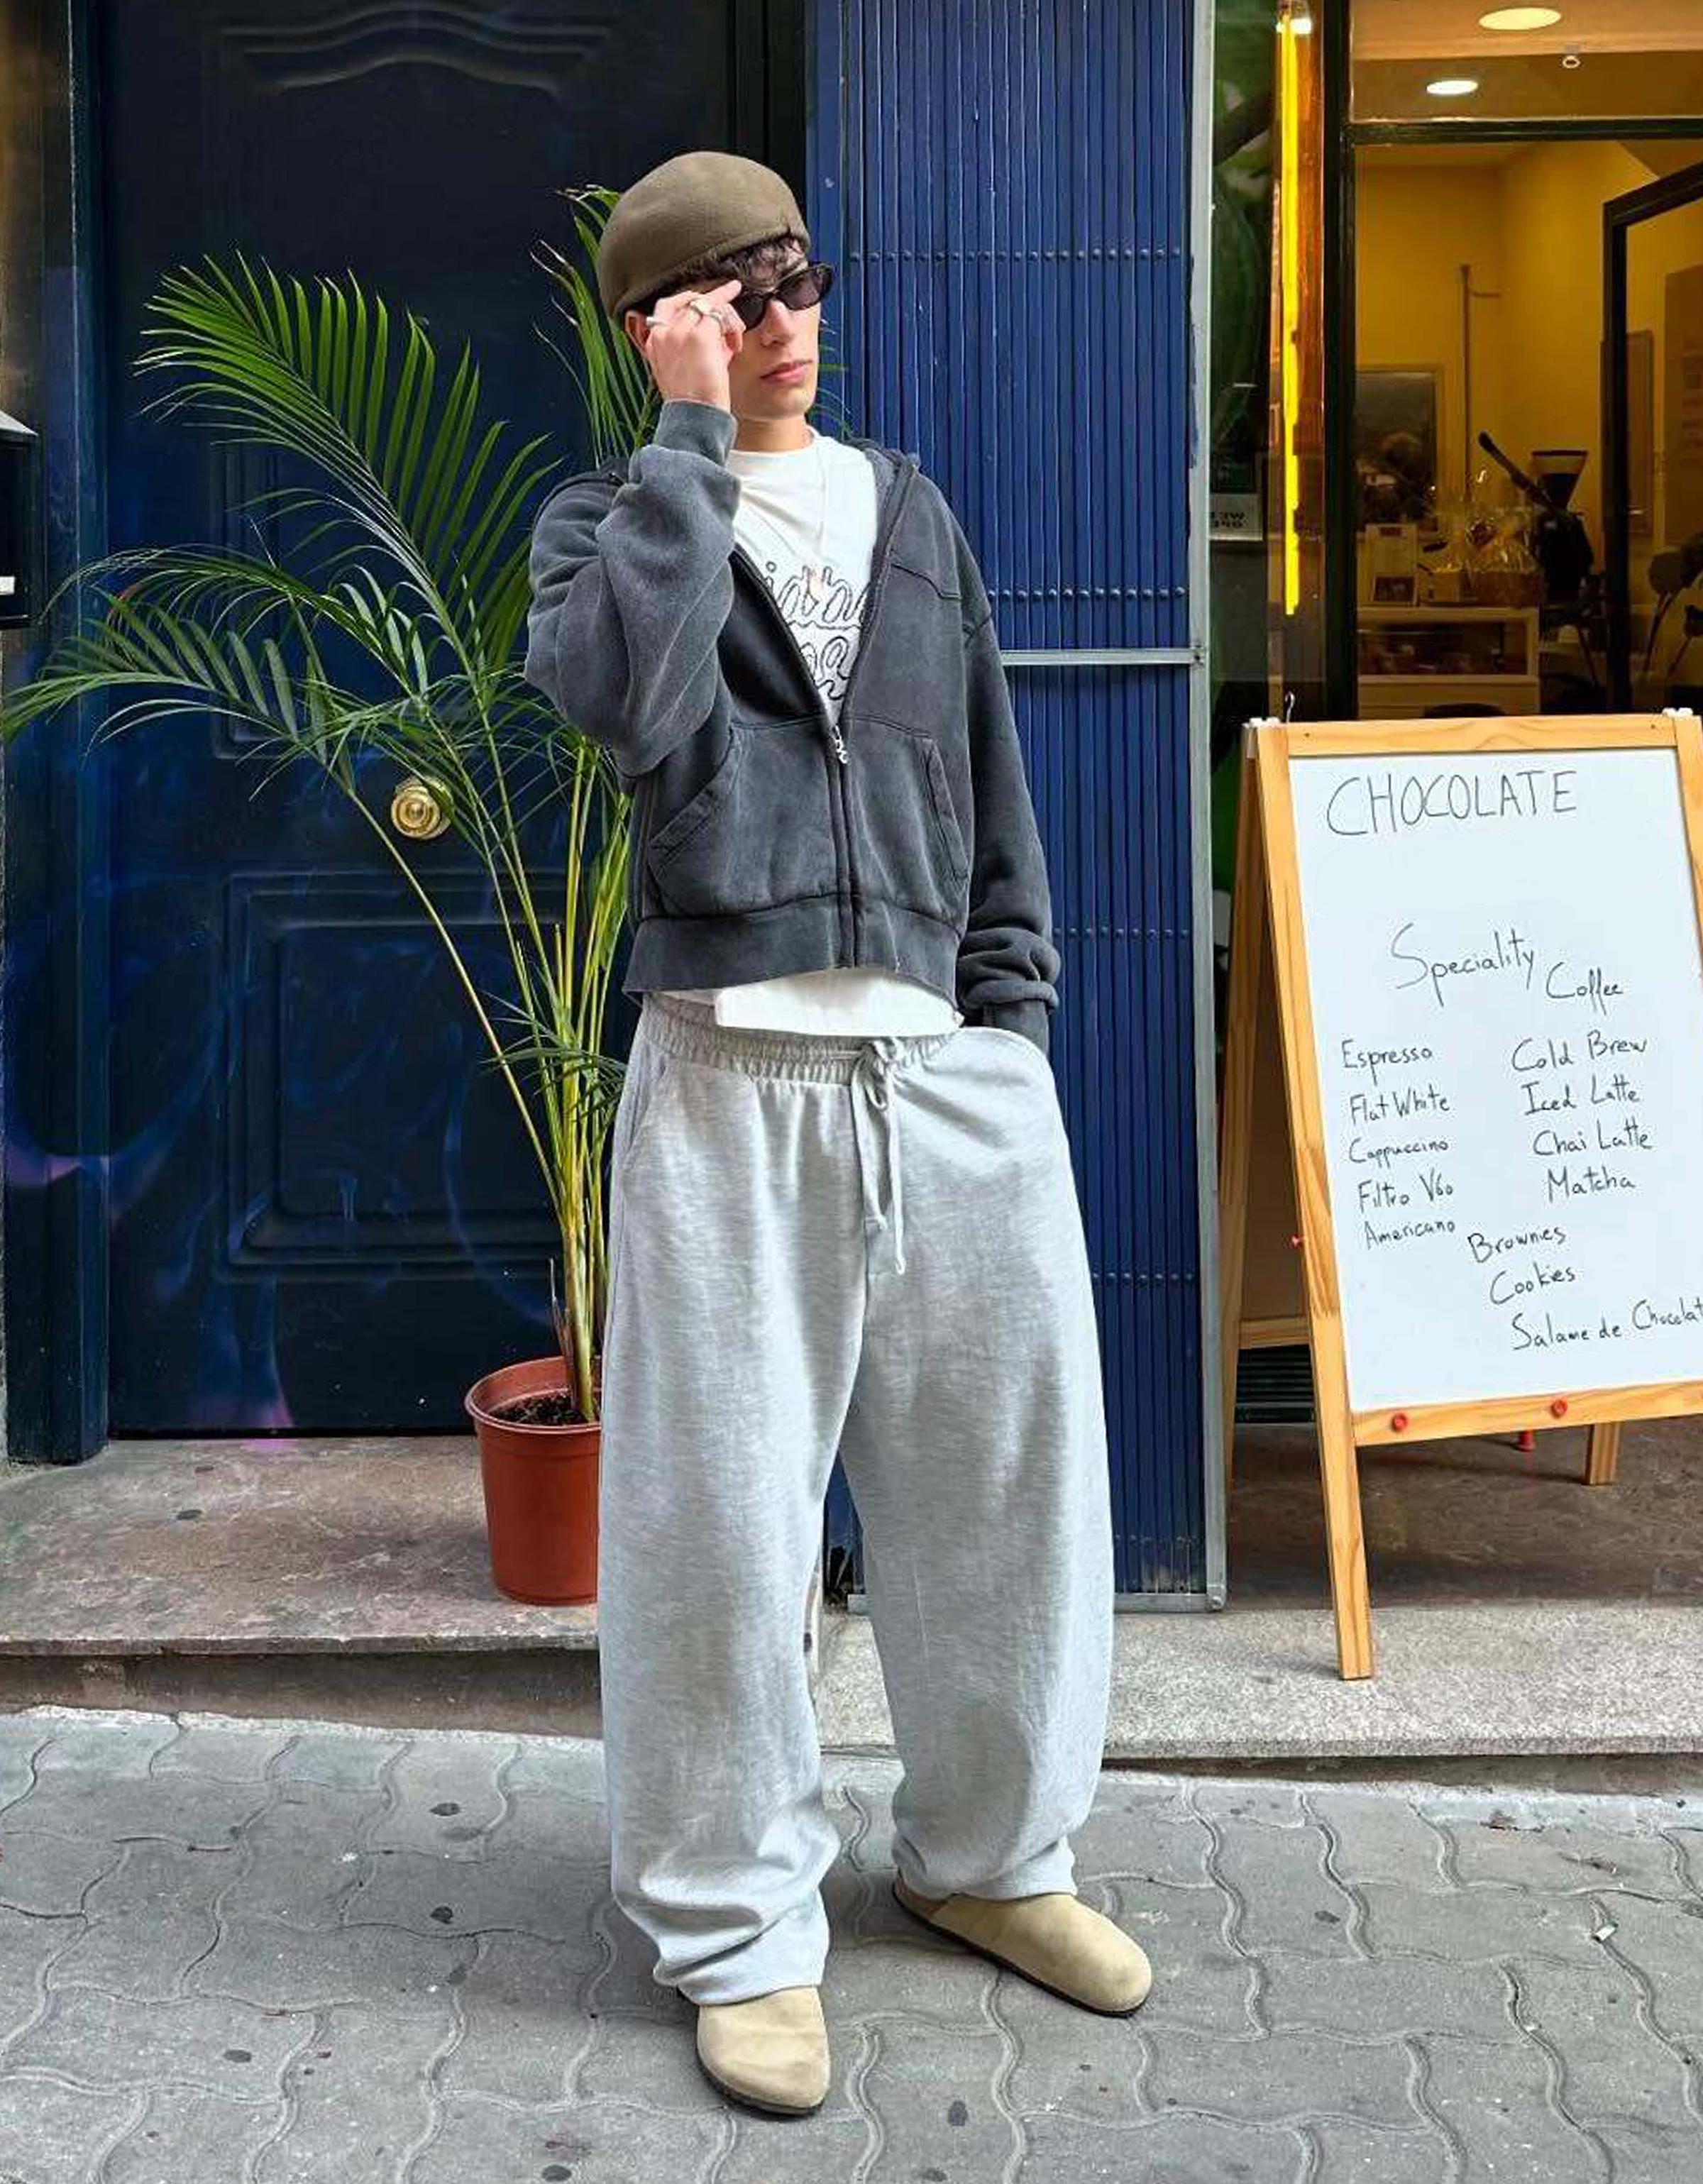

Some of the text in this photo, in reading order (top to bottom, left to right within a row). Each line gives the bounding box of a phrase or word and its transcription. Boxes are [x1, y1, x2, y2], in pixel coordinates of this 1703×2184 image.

[1326, 770, 1577, 836] CHOCOLATE
[1391, 922, 1624, 1015] Speciality Coffee
[1341, 1038, 1433, 1086] Espresso
[1511, 1029, 1648, 1072] Cold Brew
[1350, 1083, 1450, 1125] Flat White
[1521, 1074, 1640, 1116] Iced Latte
[1348, 1137, 1449, 1169] Cappuccino
[1533, 1116, 1653, 1157] Chai Latte
[1357, 1179, 1411, 1213] Filtro
[1547, 1165, 1636, 1203] Matcha
[1364, 1220, 1455, 1250] Americano
[1489, 1262, 1576, 1306] Cookies
[1511, 1296, 1703, 1351] Salame de Chocolat
